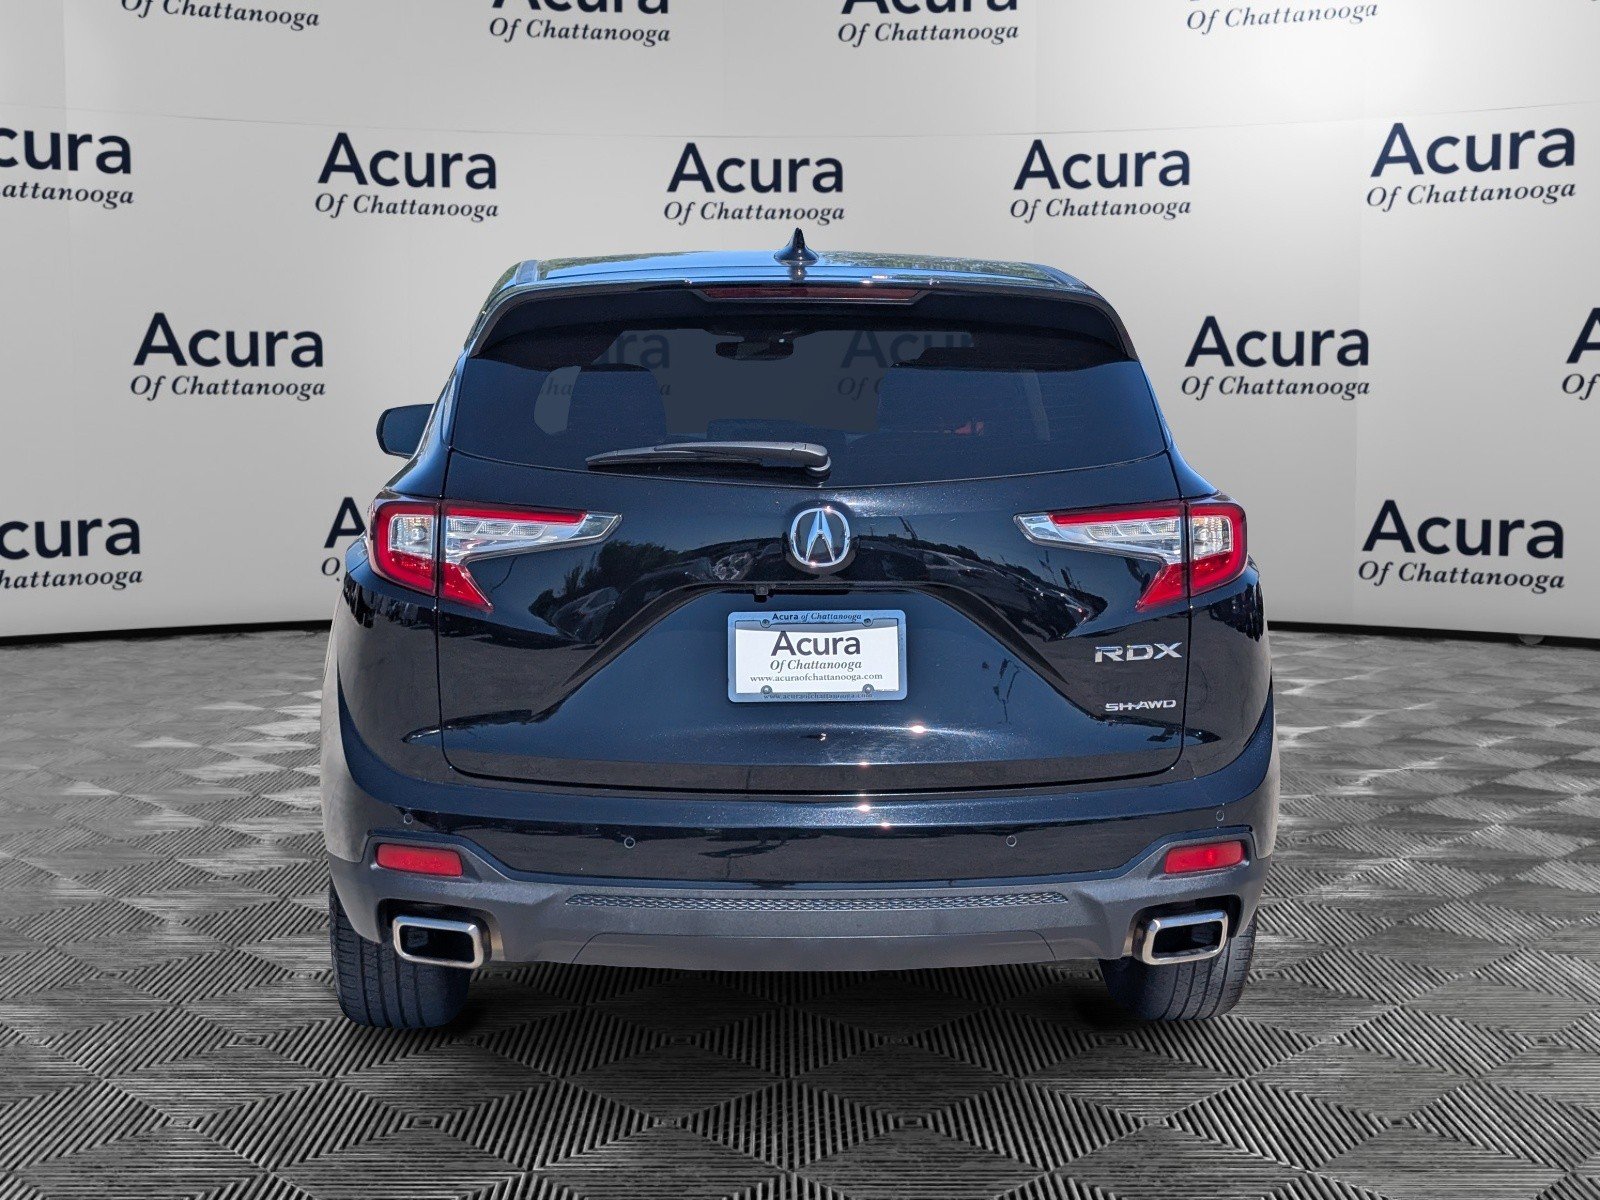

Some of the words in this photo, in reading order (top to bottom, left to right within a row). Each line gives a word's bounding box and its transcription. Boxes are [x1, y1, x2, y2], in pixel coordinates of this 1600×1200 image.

[162, 0, 319, 31] Chattanooga
[1187, 9, 1220, 35] Of
[1225, 4, 1377, 27] Chattanooga
[489, 17, 522, 43] Of
[526, 19, 670, 47] Chattanooga
[838, 22, 870, 48] Of
[875, 22, 1018, 45] Chattanooga
[317, 132, 497, 190] Acura
[1370, 123, 1576, 177] Acura
[667, 142, 844, 195] Acura
[1013, 139, 1190, 192] Acura
[315, 193, 348, 219] Of
[353, 194, 498, 223] Chattanooga
[1010, 198, 1042, 224] Of
[1046, 198, 1191, 219] Chattanooga
[1367, 186, 1402, 212] Of
[1407, 184, 1576, 206] Chattanooga
[664, 201, 696, 226] Of
[700, 201, 844, 227] Chattanooga
[133, 312, 324, 368] Acura
[1184, 315, 1369, 368] Acura
[130, 375, 166, 401] Of
[171, 375, 325, 401] Chattanooga
[1181, 376, 1214, 401] Of
[1218, 376, 1370, 401] Chattanooga
[1562, 373, 1600, 401] Of
[1362, 499, 1564, 559] Acura
[1358, 561, 1394, 586] Of
[1398, 562, 1564, 594] Chattanooga
[772, 613, 799, 621] Acura
[801, 613, 809, 622] of
[810, 612, 862, 621] Chattanooga
[770, 630, 861, 656] Acura
[1095, 642, 1182, 662] RDX
[750, 673, 883, 682] www.acuraofchattanooga.com
[770, 660, 786, 673] Of
[788, 659, 862, 672] Chattanooga
[1105, 700, 1177, 711] SH-AWD
